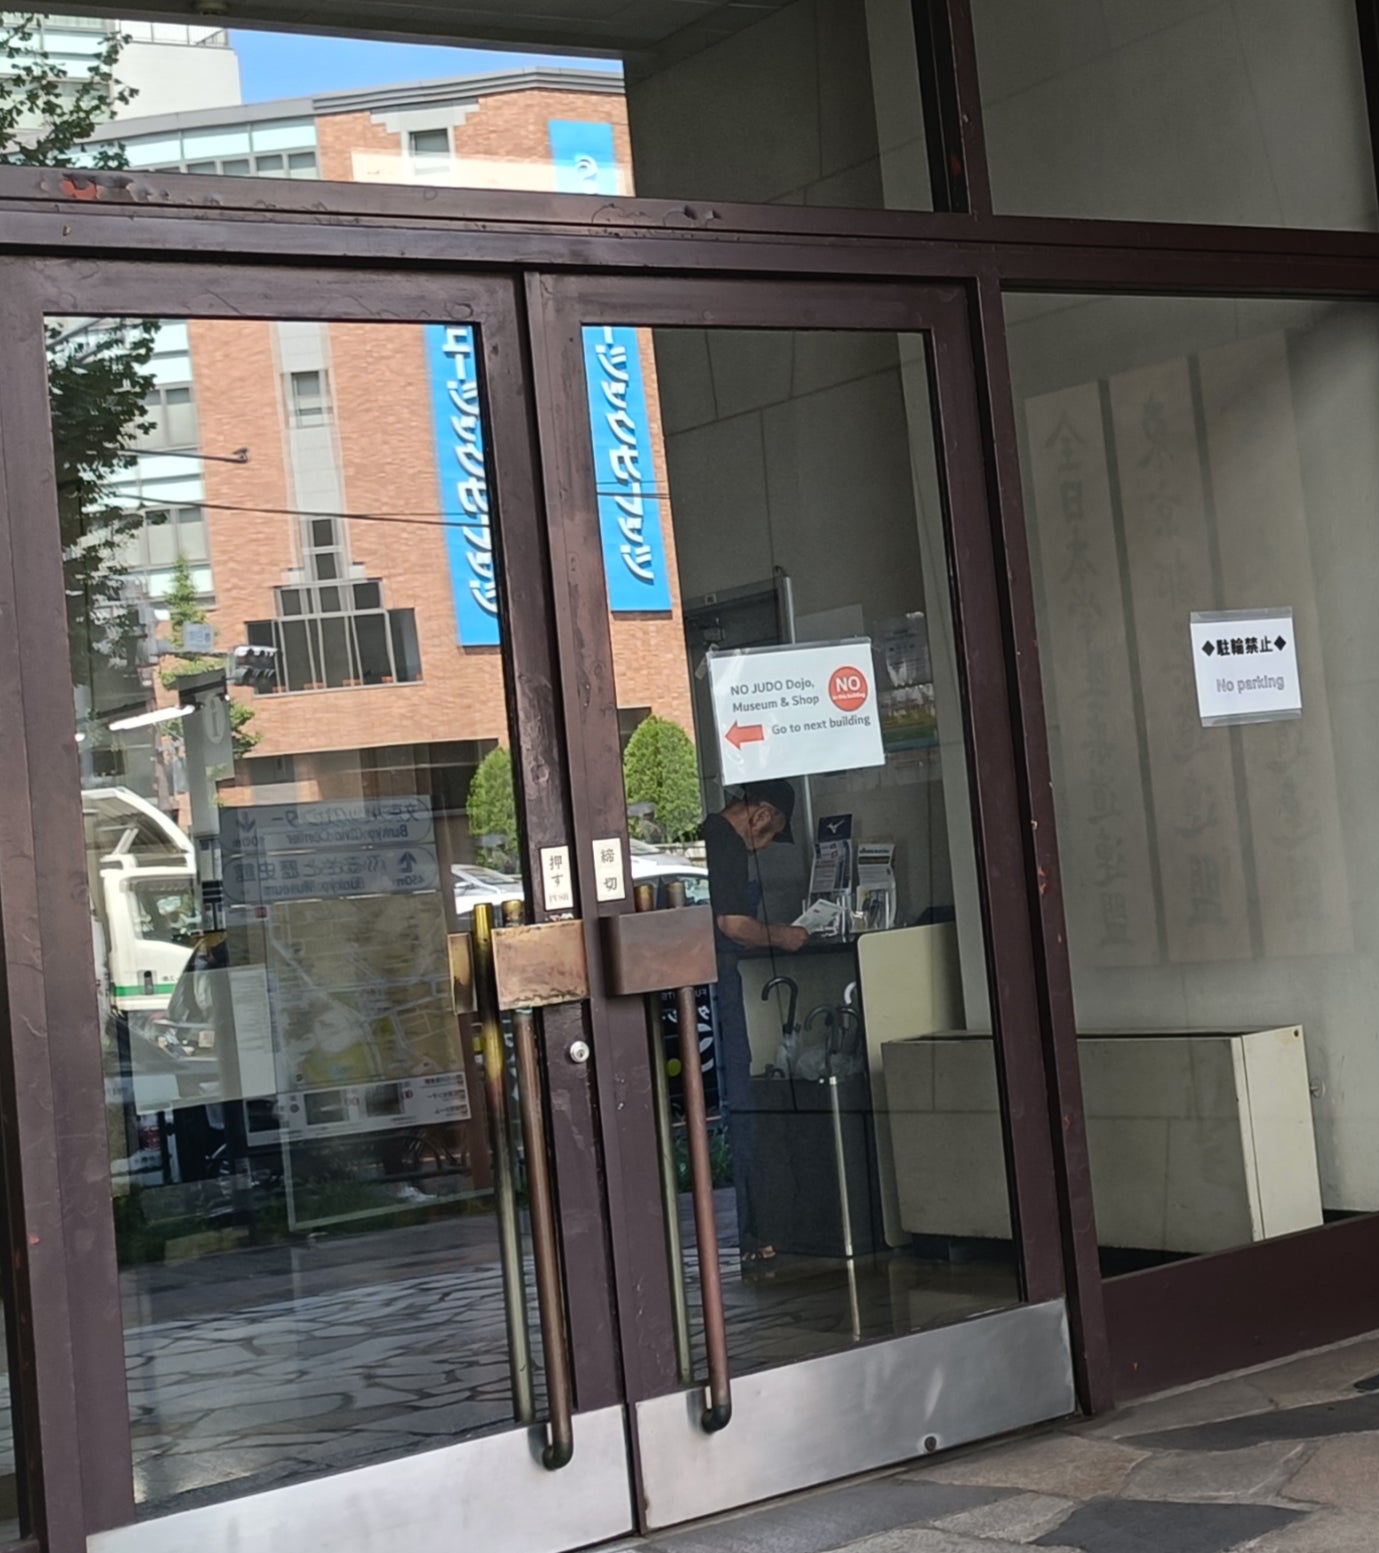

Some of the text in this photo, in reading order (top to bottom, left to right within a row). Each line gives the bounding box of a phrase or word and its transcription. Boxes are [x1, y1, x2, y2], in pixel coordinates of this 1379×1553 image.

[1216, 635, 1273, 656] 駐輪禁止
[730, 678, 815, 696] NO JUDO Dojo,
[836, 676, 861, 692] NO
[1216, 675, 1285, 694] No parking
[732, 695, 820, 713] Museum & Shop
[771, 715, 871, 735] Go to next building
[549, 855, 564, 887] 押す
[600, 848, 618, 892] 締切
